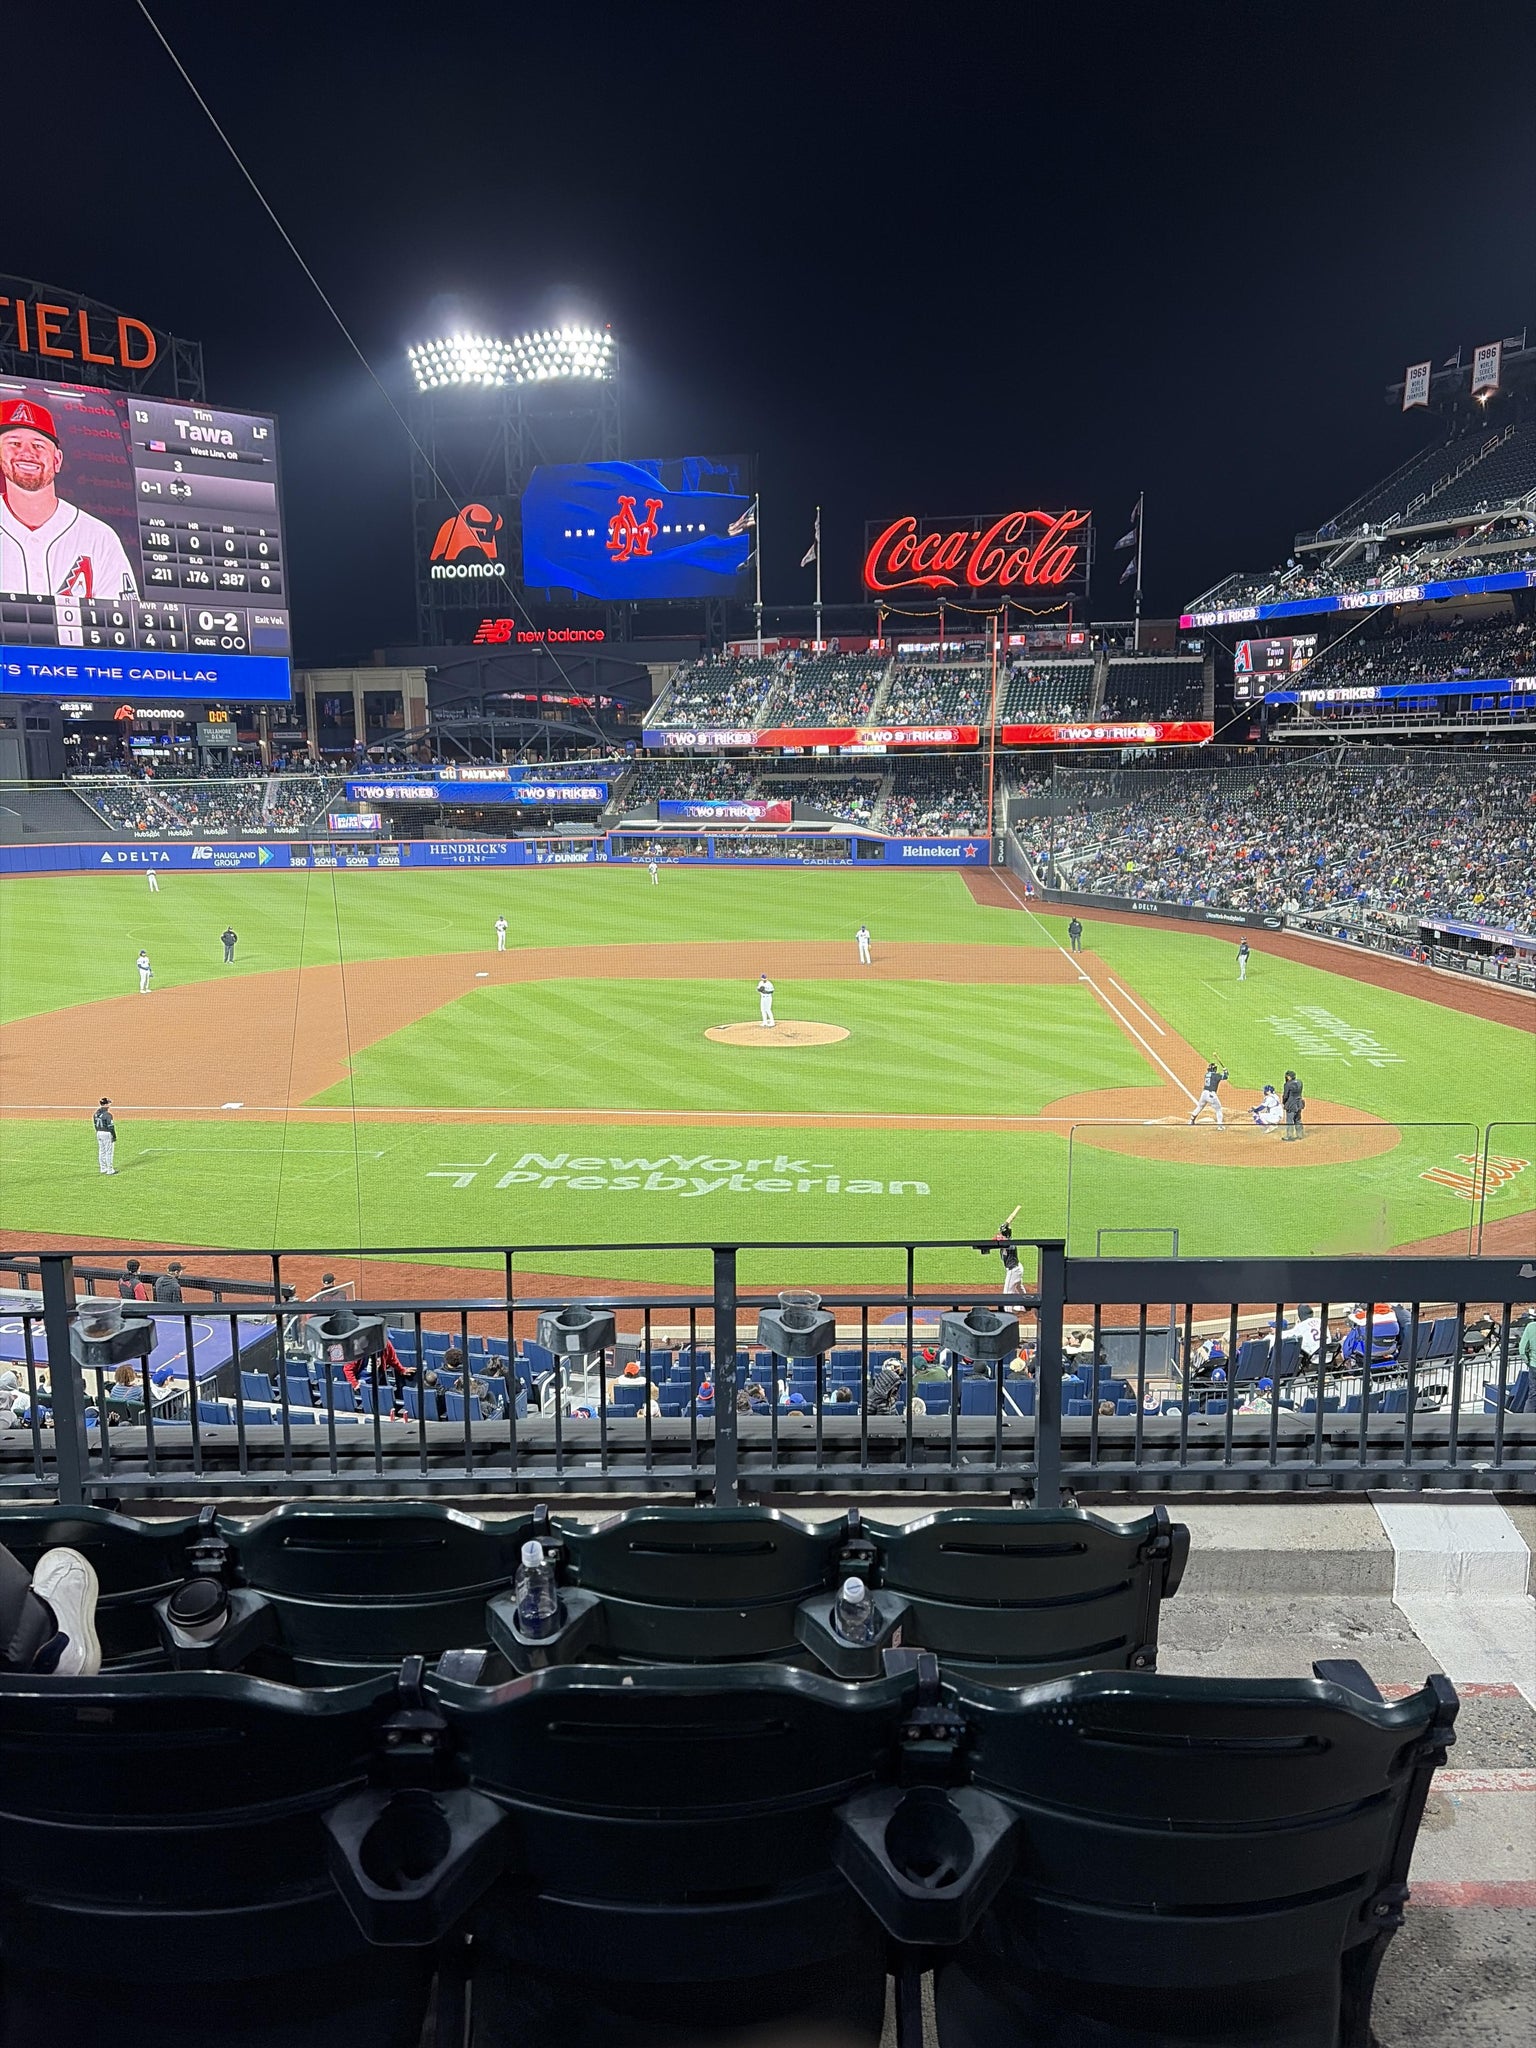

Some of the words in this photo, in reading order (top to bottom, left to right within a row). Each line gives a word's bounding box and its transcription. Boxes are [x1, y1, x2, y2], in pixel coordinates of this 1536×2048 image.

[0, 296, 157, 369] IELD
[1479, 347, 1497, 361] 1986
[1479, 361, 1493, 369] WORLD
[1479, 367, 1494, 376] SERIES
[1410, 366, 1427, 379] 1969
[1475, 373, 1497, 383] CHAMPIONS
[1407, 392, 1427, 401] CHAMPIONS
[135, 410, 149, 423] 13
[193, 409, 213, 422] Tim
[174, 419, 233, 445] Tawa
[252, 426, 268, 440] LF
[190, 446, 210, 457] West
[226, 451, 238, 460] OR
[174, 460, 183, 473] 3
[141, 481, 162, 495] 0-1
[169, 483, 192, 497] 5-3
[149, 518, 165, 527] AVG
[188, 522, 199, 531] HR
[222, 525, 235, 534] RBI
[259, 528, 266, 537] R
[564, 529, 595, 538] NEW
[662, 523, 706, 533] METS
[148, 532, 170, 546] .118
[190, 536, 200, 549] 0
[225, 539, 234, 552] 0
[258, 542, 268, 555] 0
[152, 553, 168, 562] OBP
[189, 556, 204, 565] SLG
[223, 559, 239, 568] OPS
[431, 562, 506, 579] moomoo
[151, 567, 173, 581] .211
[186, 570, 209, 584] .176
[219, 573, 245, 586] .387
[261, 576, 270, 588] 0
[88, 599, 95, 607] H
[139, 602, 157, 611] MVR
[163, 603, 178, 612] ABS
[64, 610, 74, 622] 0
[90, 610, 97, 624] 1
[112, 612, 123, 626] 0
[144, 614, 154, 628] 3
[168, 615, 175, 629] 1
[198, 611, 239, 632] 0-2
[254, 615, 269, 625] Exit
[67, 630, 73, 642] 1
[90, 630, 101, 644] 5
[114, 631, 125, 645] 0
[145, 633, 156, 647] 4
[170, 634, 177, 648] 1
[516, 629, 547, 643] new
[547, 627, 605, 643] balance
[194, 637, 216, 647] Outs:
[1266, 648, 1285, 656] Tawa
[27, 664, 79, 678] TAKE
[84, 666, 123, 679] THE
[129, 668, 218, 682] CADILLAC
[1300, 690, 1326, 702] TWO
[136, 708, 185, 719] moomoo
[208, 710, 228, 723] 0:09
[429, 843, 508, 854] HENDRICK'S
[902, 845, 960, 857] Heineken
[117, 851, 170, 862] DELTA
[213, 851, 257, 860] HAUGLAND
[290, 857, 307, 867] 380
[345, 857, 369, 866] GOYA
[377, 857, 400, 866] GOYA
[555, 854, 589, 863] DUNKIN'
[595, 853, 608, 862] 370
[631, 856, 680, 864] CADILLAC
[213, 859, 241, 867] GROUP
[1138, 902, 1158, 912] DELTA
[512, 1152, 835, 1173] NewYork-
[495, 1170, 931, 1197] Presbyterian
